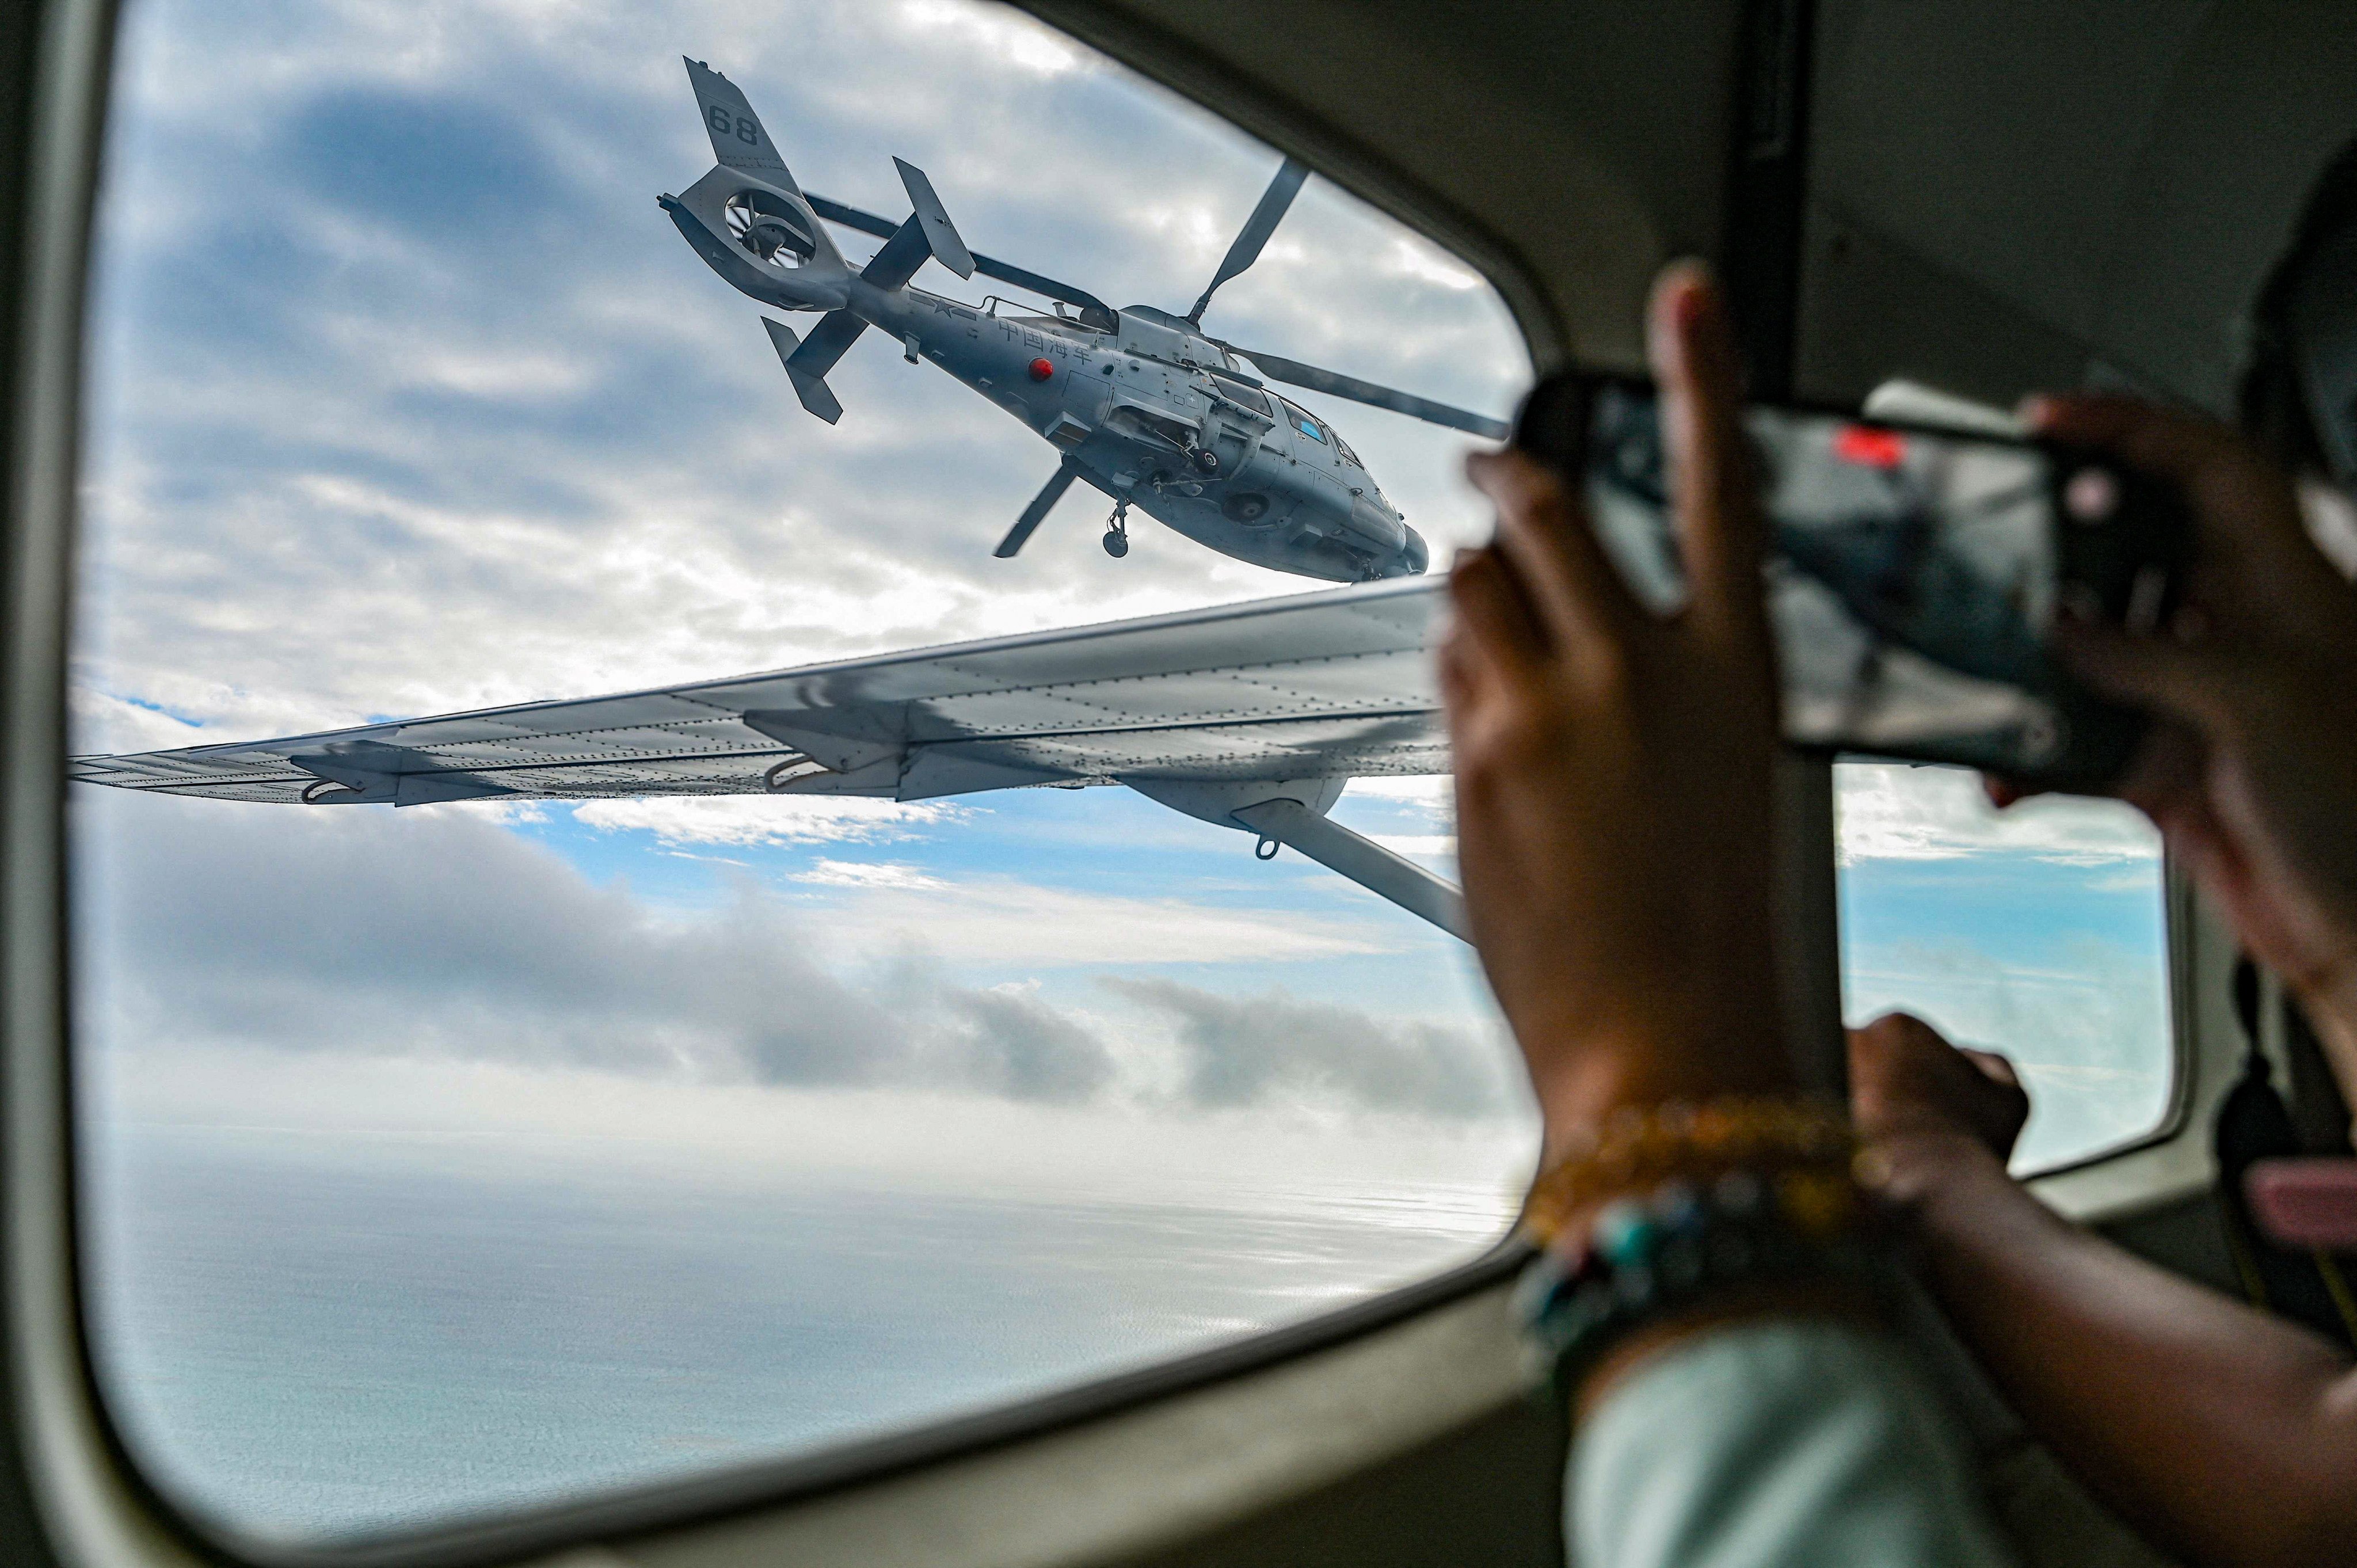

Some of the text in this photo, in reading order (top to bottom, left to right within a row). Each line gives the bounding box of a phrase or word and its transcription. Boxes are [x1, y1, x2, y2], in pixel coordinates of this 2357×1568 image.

[710, 105, 757, 146] 68
[998, 319, 1092, 365] 中国海军
